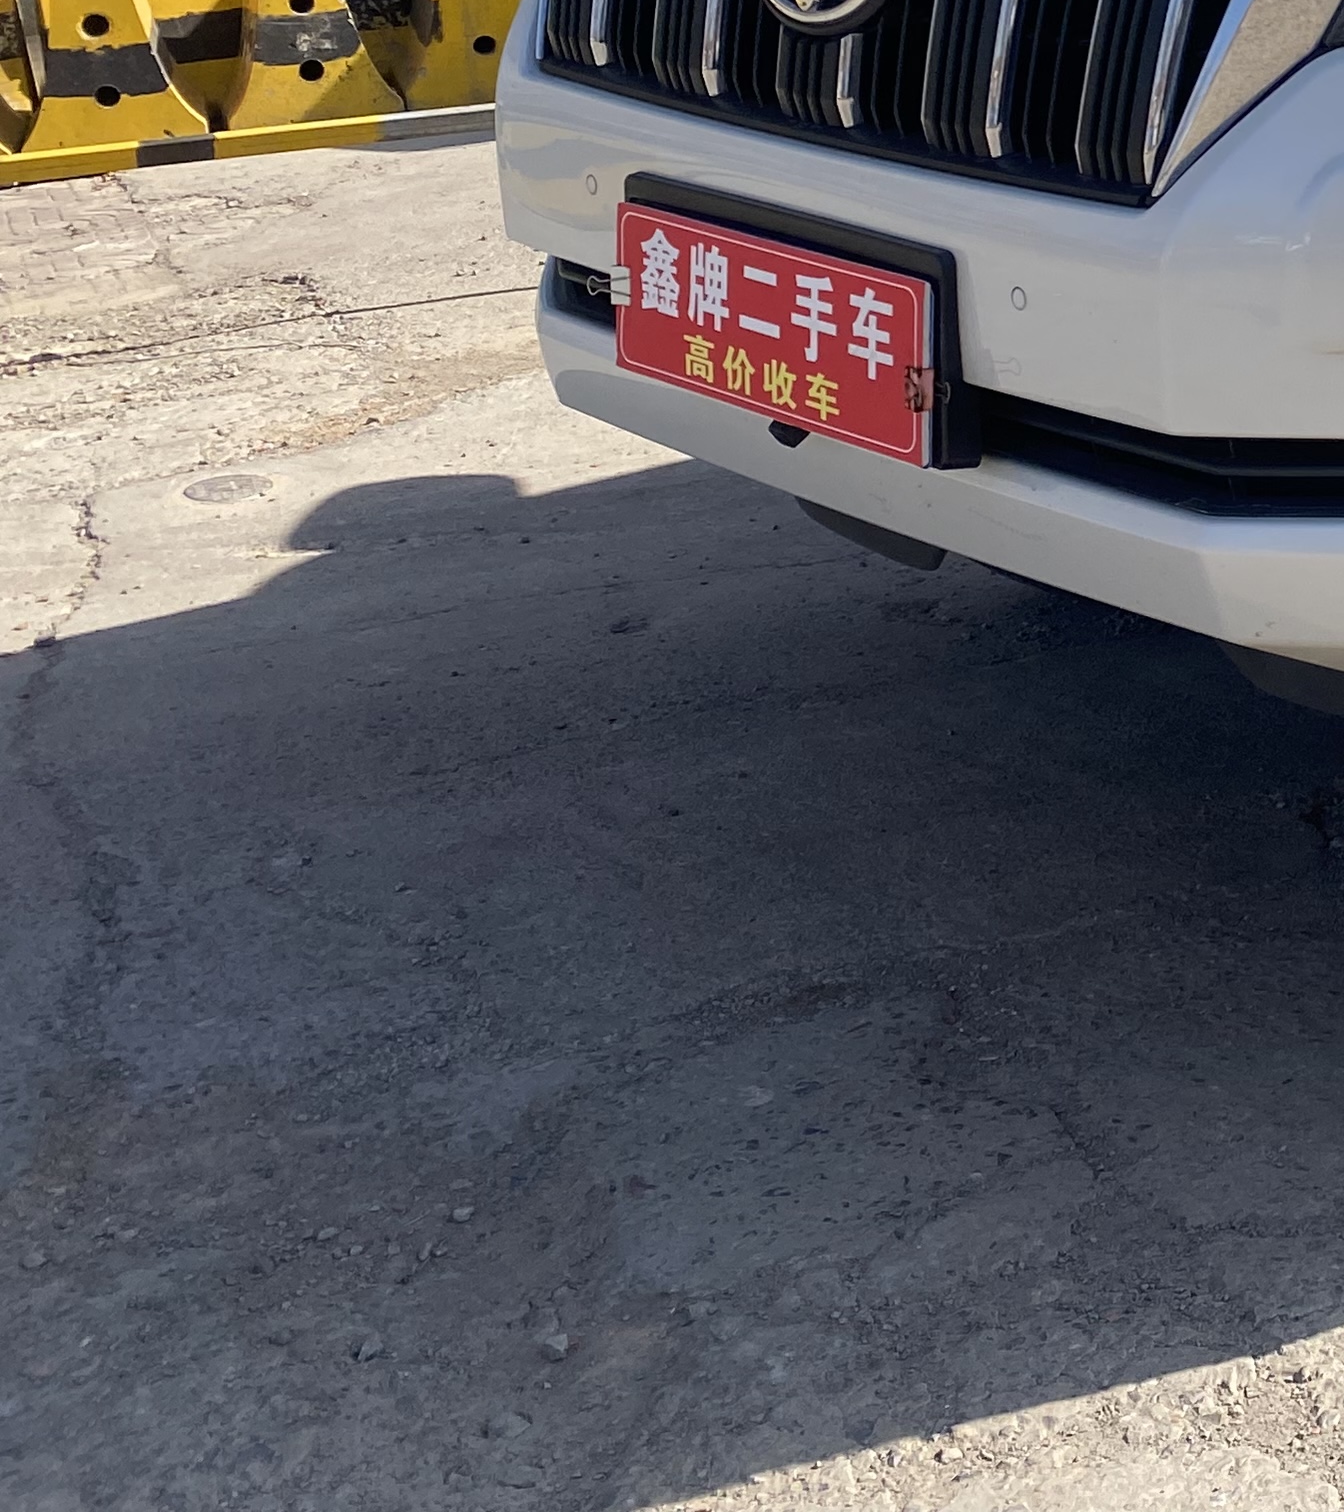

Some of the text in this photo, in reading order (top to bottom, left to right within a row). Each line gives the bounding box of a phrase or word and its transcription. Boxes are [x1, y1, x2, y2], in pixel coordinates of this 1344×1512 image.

[639, 228, 895, 381] 鑫牌二手车
[683, 334, 841, 421] 高价收车
